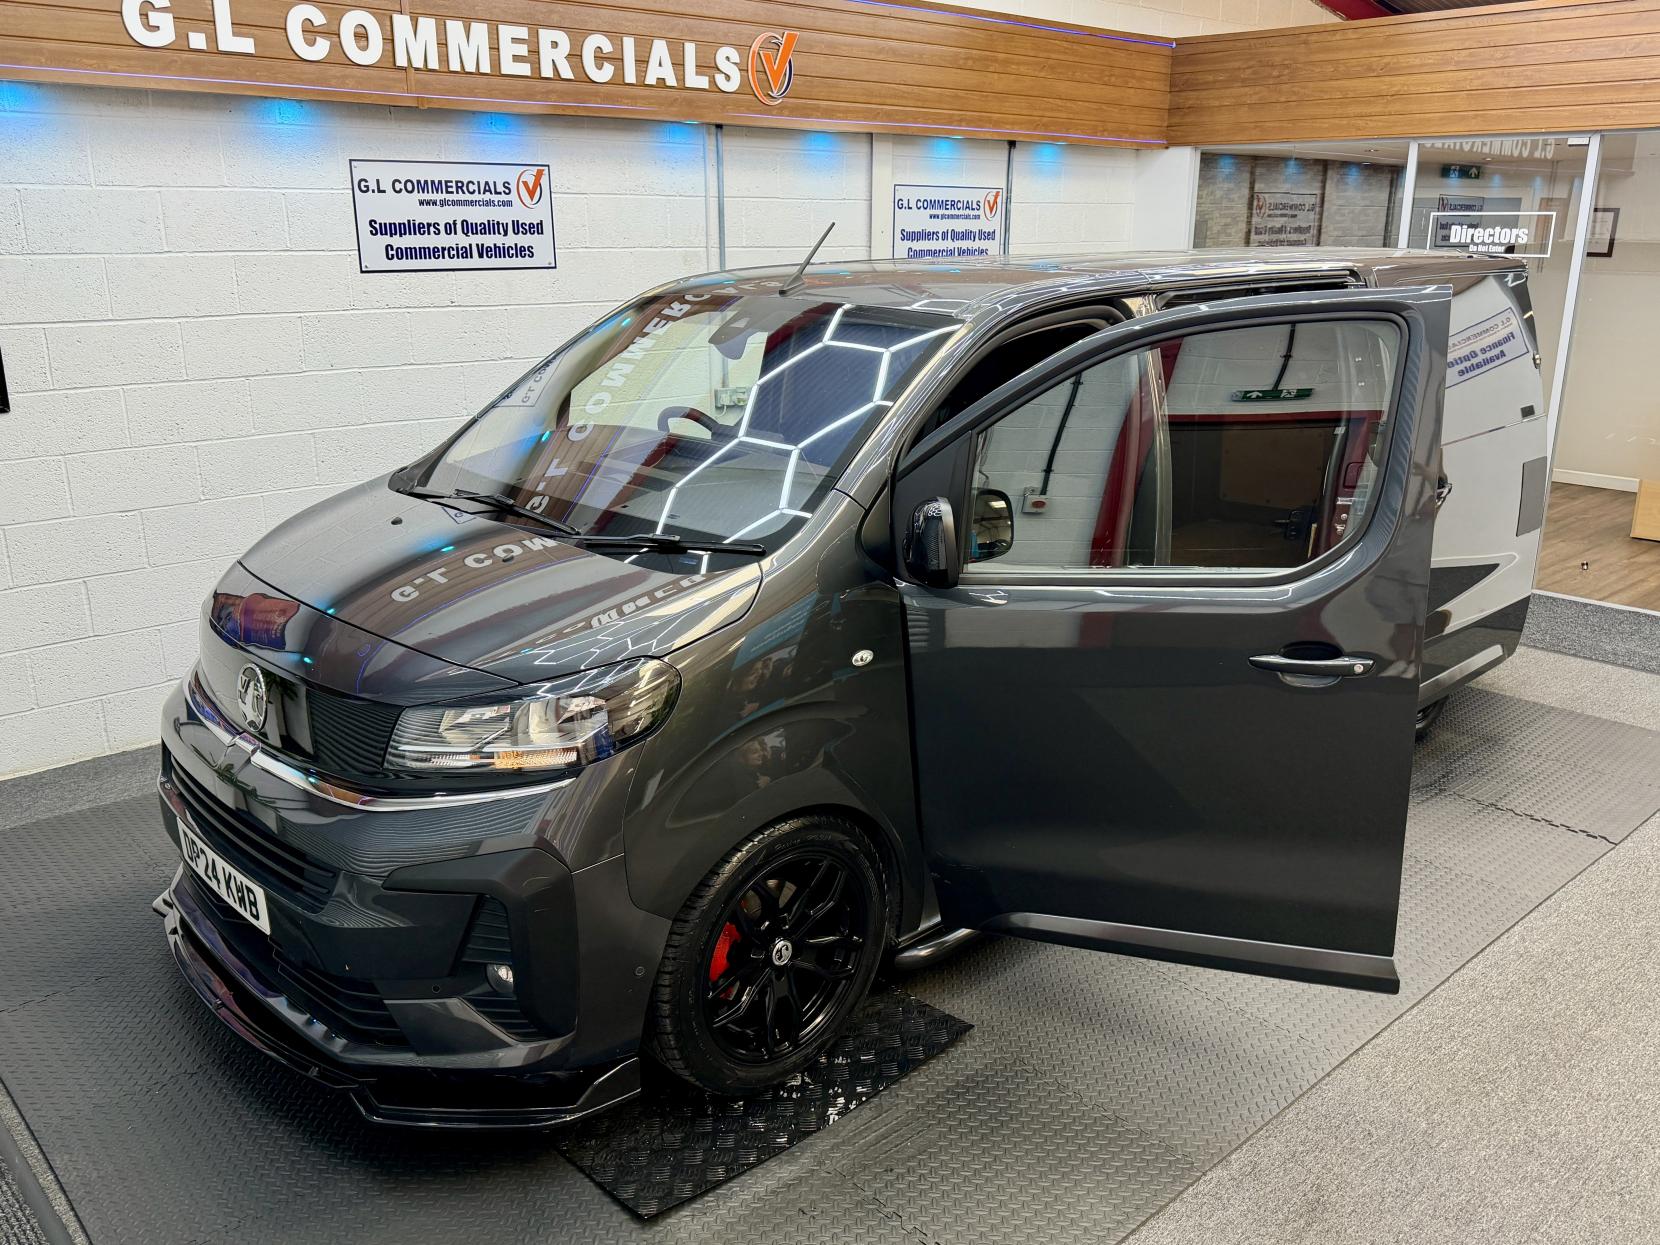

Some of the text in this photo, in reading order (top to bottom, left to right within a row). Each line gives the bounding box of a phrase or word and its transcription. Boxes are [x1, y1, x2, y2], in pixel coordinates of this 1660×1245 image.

[121, 0, 740, 93] G.L COMMERCIALS
[357, 178, 512, 196] G.L COMMERCIALS
[418, 198, 513, 208] www.glcommercials.com
[897, 198, 981, 211] G.L COMMERCIALS
[368, 219, 544, 238] Suppliers of Quality Used
[900, 228, 996, 242] Suppliers of Quality Used
[1450, 225, 1528, 243] Directors
[385, 243, 534, 260] Commercial Vehicles
[907, 247, 955, 258] Commercial
[1477, 244, 1488, 252] Not
[222, 865, 260, 922] KWB
